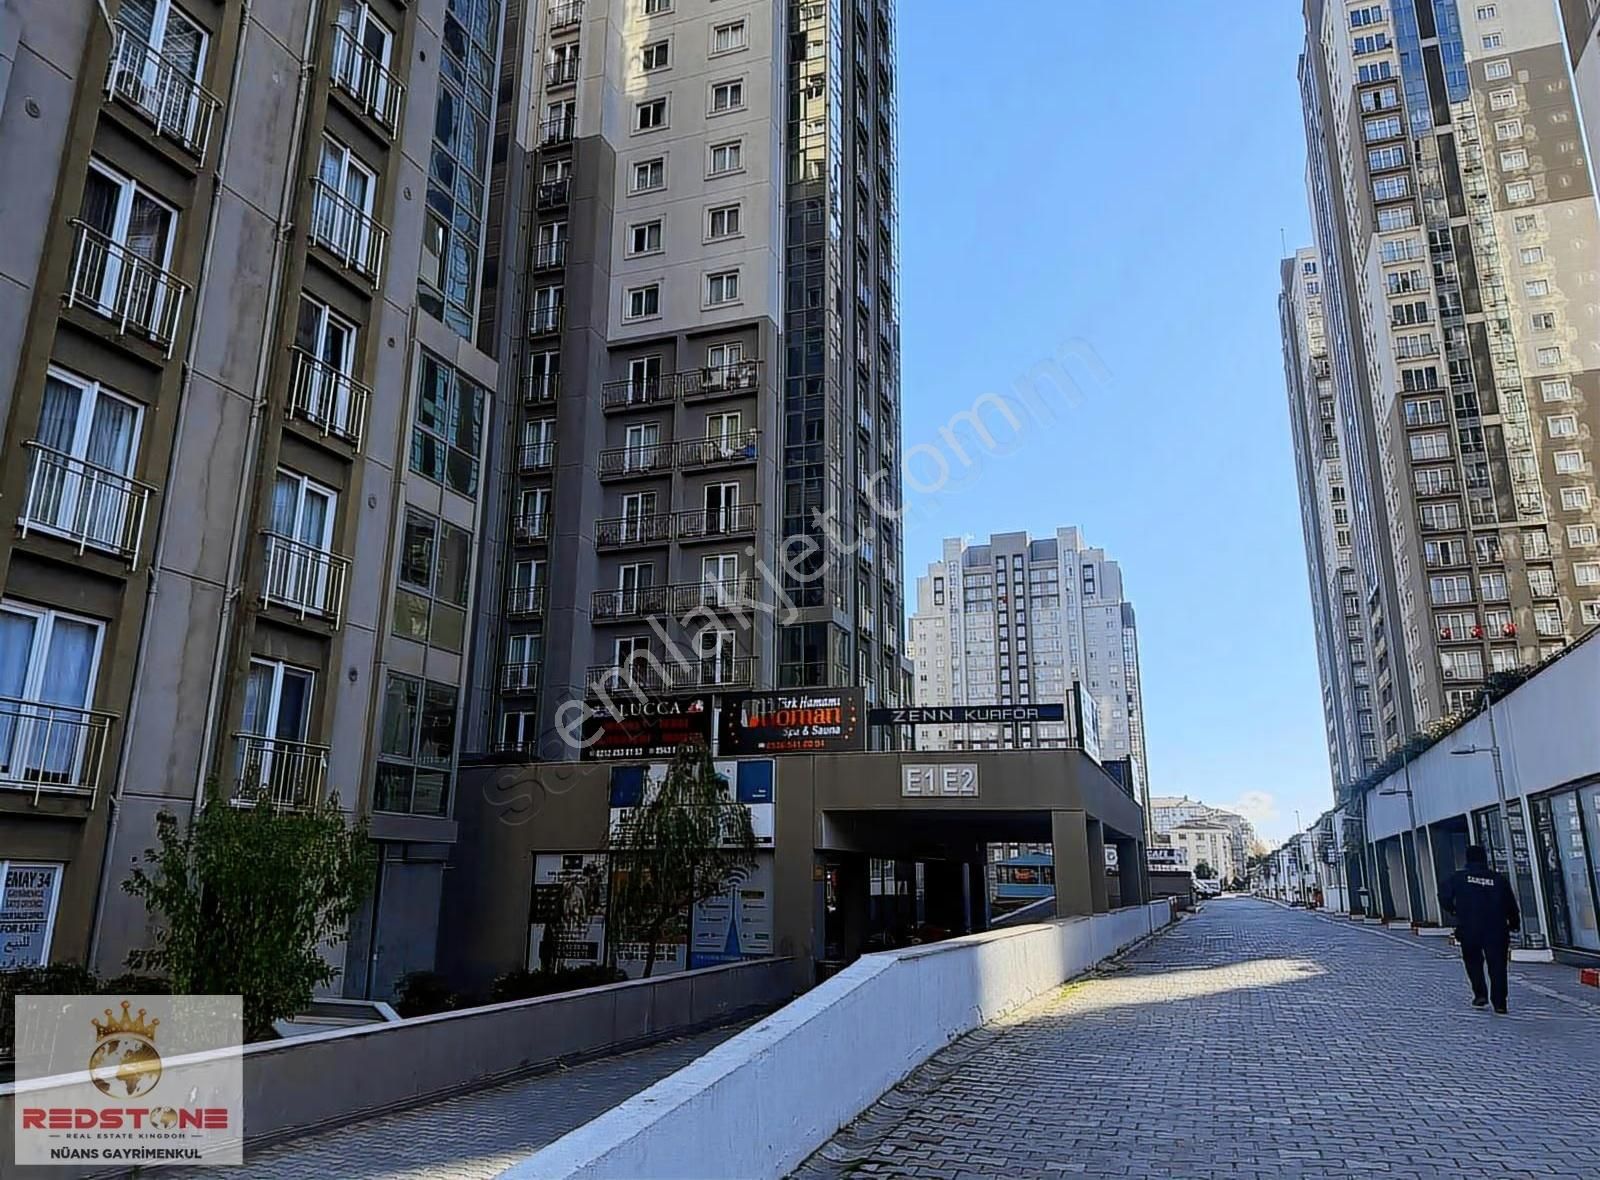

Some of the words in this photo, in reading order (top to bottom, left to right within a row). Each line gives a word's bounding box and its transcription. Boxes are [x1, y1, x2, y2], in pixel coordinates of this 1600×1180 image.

[620, 701, 681, 716] LUCCA
[892, 709, 953, 722] ZENN
[811, 726, 841, 735] Sauna
[906, 767, 935, 793] E1
[942, 767, 976, 793] E2
[19, 924, 40, 933] SALE
